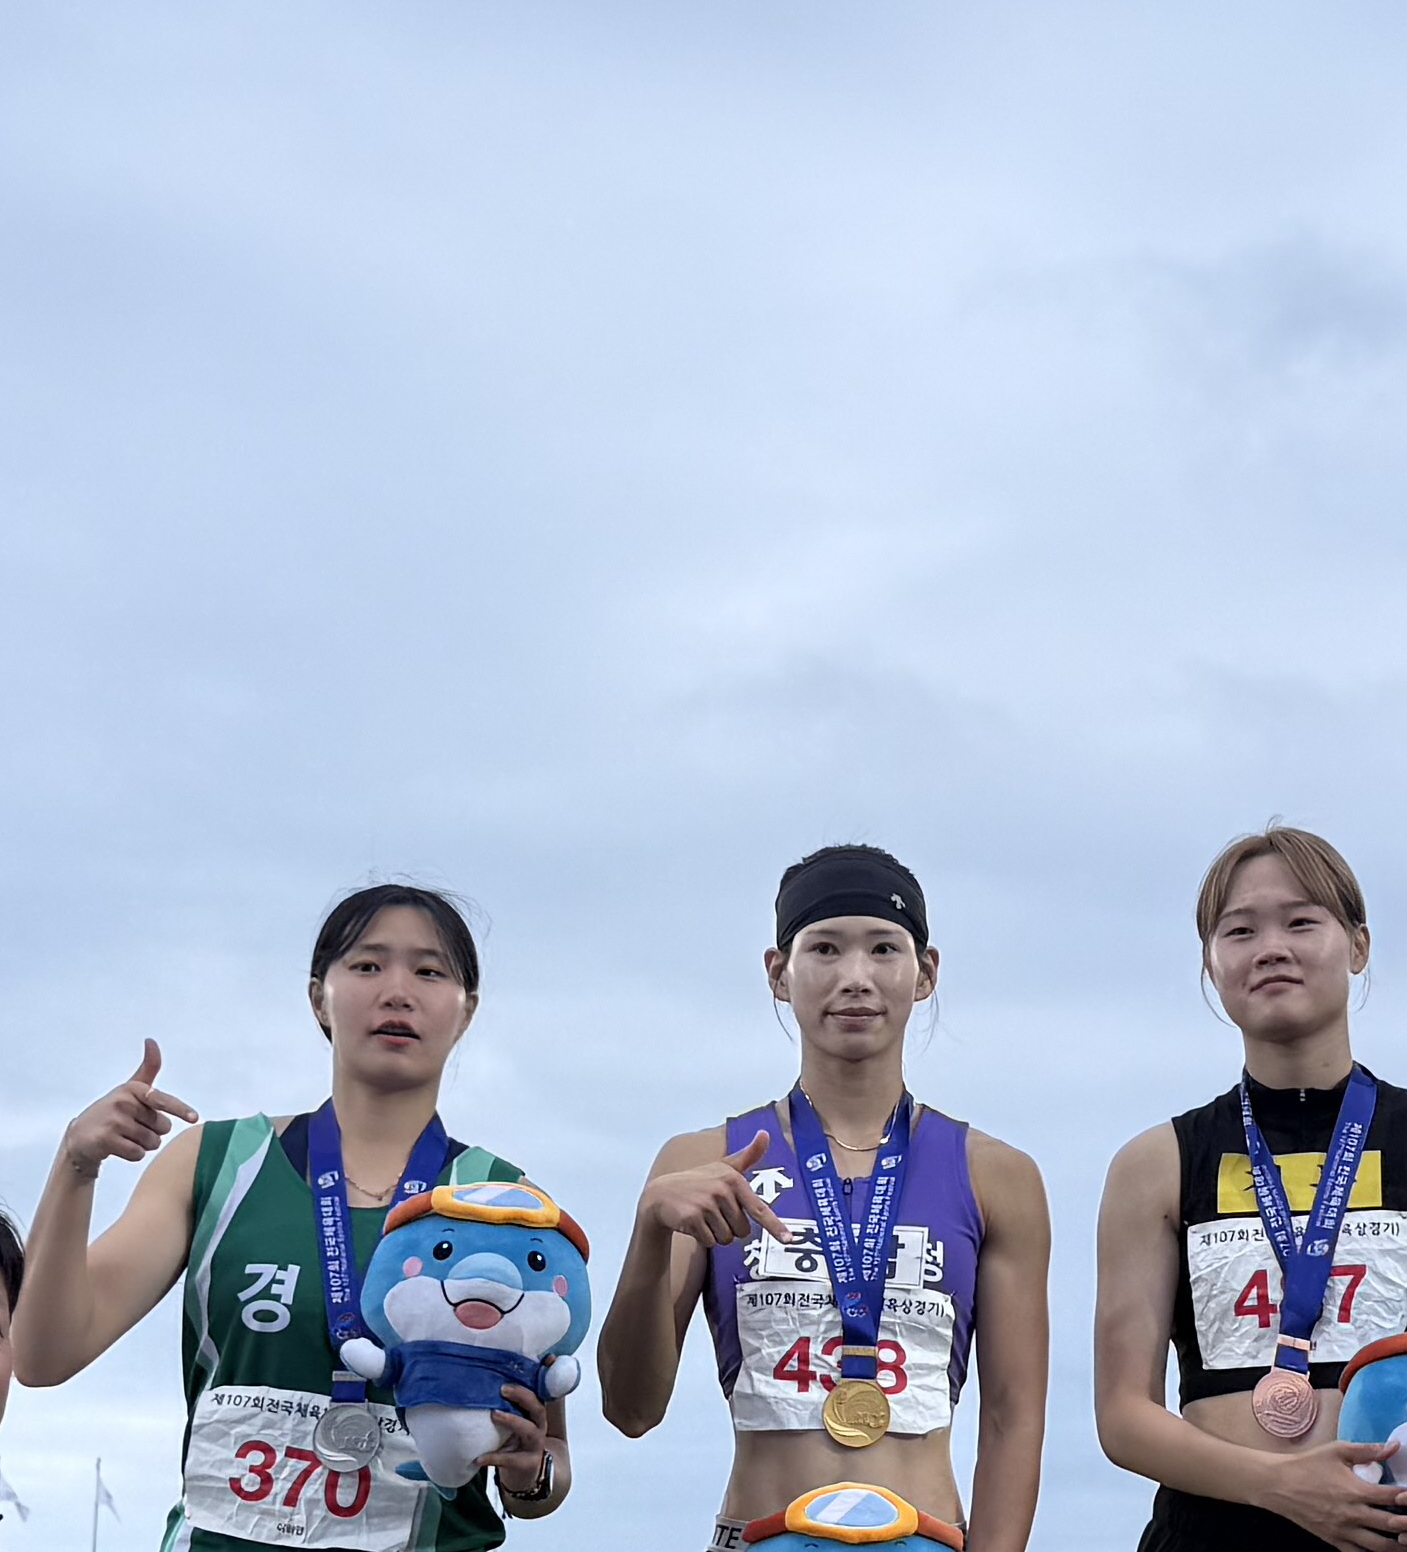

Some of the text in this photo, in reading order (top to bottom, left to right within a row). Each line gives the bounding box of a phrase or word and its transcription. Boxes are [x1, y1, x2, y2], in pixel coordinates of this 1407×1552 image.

[320, 1196, 344, 1304] 제107회 전국체육대회
[236, 1263, 301, 1333] 경
[1233, 1263, 1367, 1329] 47
[228, 1439, 372, 1518] 370
